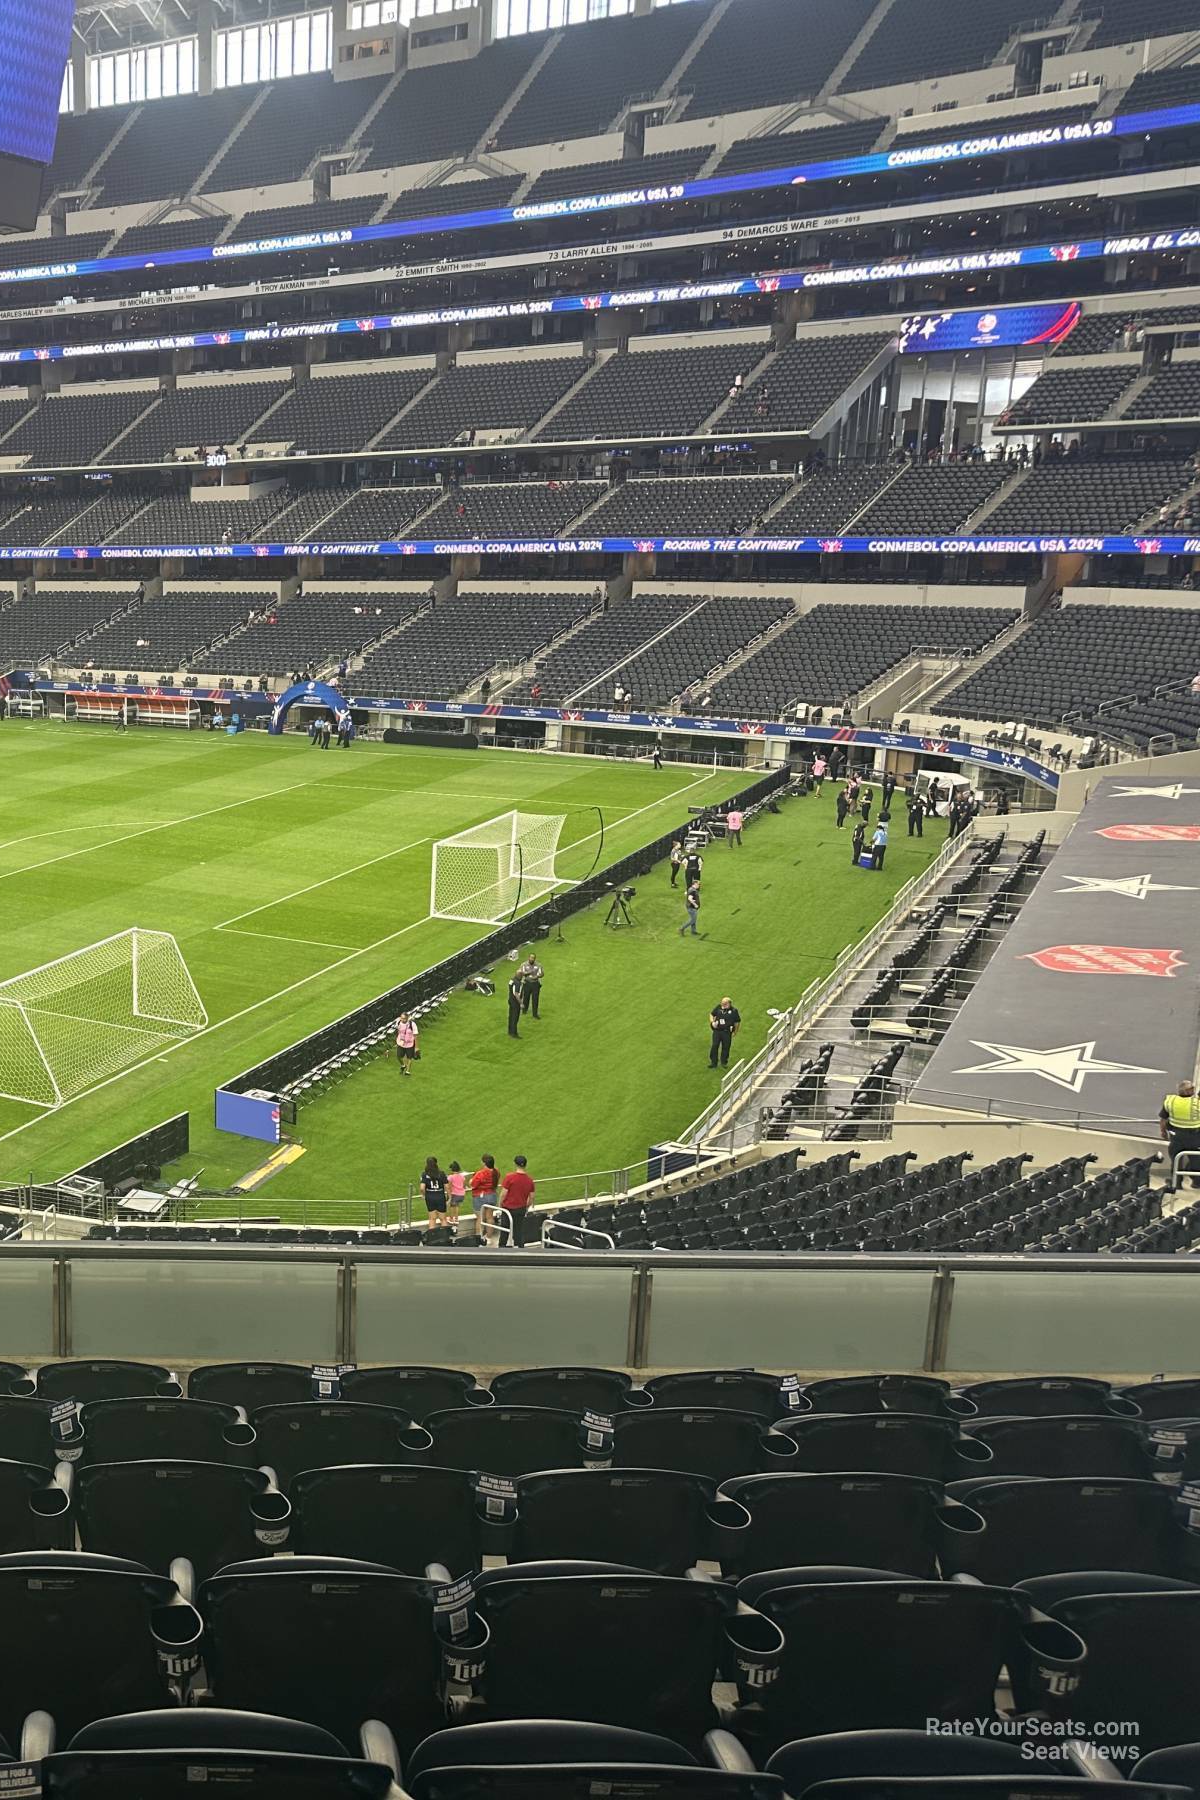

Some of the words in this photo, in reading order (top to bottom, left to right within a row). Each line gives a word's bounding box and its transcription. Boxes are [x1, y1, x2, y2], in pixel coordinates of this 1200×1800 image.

[888, 145, 959, 165] CONMEBOL
[961, 138, 997, 154] COPA
[997, 129, 1061, 151] AMERICA
[1065, 124, 1090, 139] USA
[512, 202, 568, 218] CONMEBOL
[570, 198, 597, 210] COPA
[596, 191, 645, 207] AMERICA
[648, 188, 667, 200] USA
[723, 231, 733, 239] 94
[737, 224, 788, 237] DEMARCUS
[791, 219, 818, 231] WARE
[824, 218, 838, 226] 2005
[212, 243, 258, 256] CONMEBOL
[259, 240, 281, 250] COPA
[281, 235, 321, 247] AMERICA
[323, 232, 339, 243] USA
[1104, 237, 1150, 253] VIBRA
[1153, 235, 1174, 249] EL
[803, 268, 869, 285] CONMEBOL
[870, 264, 902, 279] COPA
[901, 257, 959, 276] AMERICA
[962, 255, 987, 269] USA
[989, 251, 1022, 267] 2024
[609, 291, 653, 305] ROCKING
[657, 288, 679, 301] THE
[680, 280, 742, 298] CONTINENT
[391, 313, 441, 327] CONMEBOL
[442, 310, 465, 323] COPA
[463, 306, 508, 320] AMERICA
[510, 304, 528, 314] USA
[530, 301, 553, 313] 2024
[0, 549, 10, 557] EL
[12, 549, 59, 557] CONTINENTE
[101, 549, 142, 558] CONMEBOL
[142, 549, 162, 558] COPA
[161, 548, 197, 557] AMERICA
[198, 547, 213, 556] USA
[214, 546, 233, 555] 2024
[284, 546, 309, 554] VIBRA
[312, 546, 319, 554] O
[321, 544, 380, 554] CONTINENTE
[434, 544, 485, 553] CONMEBOL
[486, 544, 512, 553] COPA
[511, 543, 556, 552] AMERICA
[558, 542, 577, 551] USA
[578, 541, 603, 550] 2024
[663, 540, 711, 551] ROCKING
[713, 540, 737, 551] THE
[737, 540, 804, 550] CONTINENT
[868, 541, 939, 552] CONMEBOL
[940, 541, 976, 552] COPA
[975, 541, 1036, 552] AMERICA
[1040, 540, 1066, 551] USA
[1068, 539, 1104, 550] 2024
